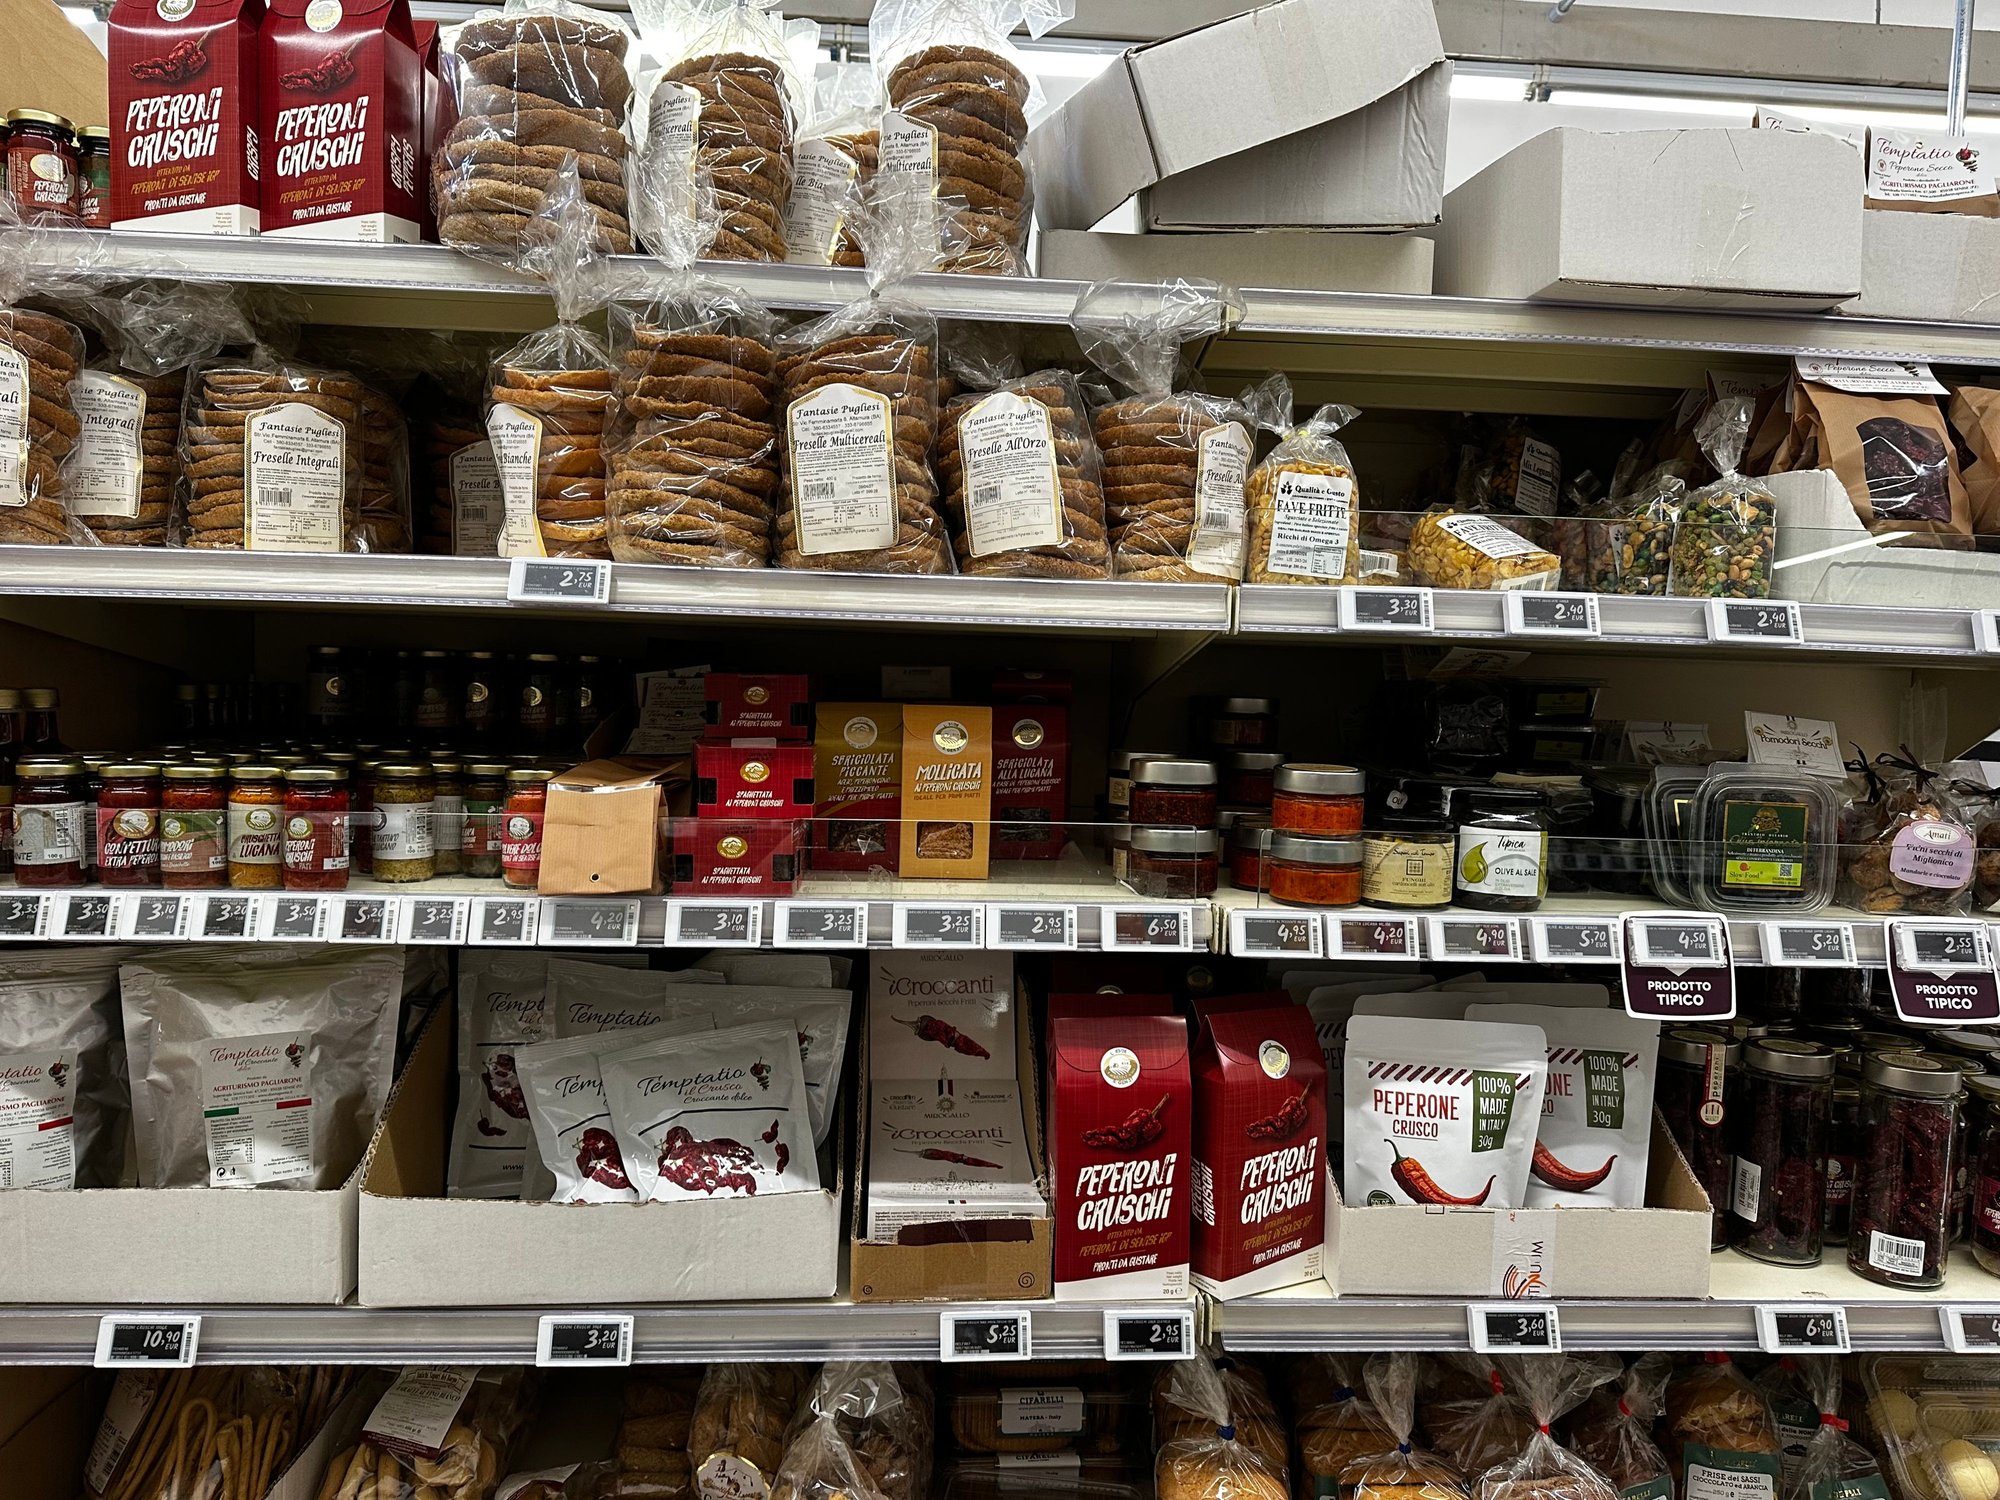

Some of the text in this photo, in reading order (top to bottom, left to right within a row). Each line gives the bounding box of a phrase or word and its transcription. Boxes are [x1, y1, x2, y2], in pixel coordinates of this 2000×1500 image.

[126, 87, 222, 132] PEPERONI
[275, 96, 369, 142] PEPERONI
[128, 123, 219, 168] CRUSCHI
[1877, 138, 1953, 164] Temptatio
[277, 132, 365, 178] CRUSCHI
[1889, 161, 1953, 173] Peperone Secco
[33, 181, 68, 194] PEPERONI
[1881, 179, 1974, 188] AGRITURISMO PAGLIARONE
[144, 192, 207, 211] PRONTI DA GUSTARE
[292, 201, 352, 220] PRONTI DA GUSTARE
[1868, 364, 1895, 373] Secco
[796, 402, 880, 419] Fantasie Pugliesi
[967, 409, 1043, 429] Fantasie Pugliesi
[85, 413, 135, 431] Integrali
[259, 422, 340, 438] Fantasie Pugliesi
[505, 422, 535, 432] Pugliesi
[794, 430, 886, 450] Freselle Multicereali
[967, 436, 1047, 463] Freselle All'Orzo
[252, 451, 339, 471] Freselle Integrali
[1205, 469, 1233, 482] Freselle
[1277, 500, 1347, 519] FAVE FRITTE
[1277, 533, 1299, 541] Ricchi
[1300, 534, 1308, 542] di
[1309, 537, 1334, 546] Omega
[559, 570, 593, 587] 2,75
[1387, 598, 1418, 615] 3,30
[1554, 603, 1583, 620] 2,40
[1757, 610, 1786, 627] 2,40
[1761, 735, 1828, 749] Pomodori Secchi
[831, 753, 895, 766] SBRICIOLATA
[839, 764, 889, 778] PICCANTE
[915, 762, 983, 781] MOLLICATA
[998, 767, 1054, 780] ALLA LUCANA
[921, 781, 953, 793] PEPERONI
[953, 781, 981, 791] CRUSCHI
[733, 799, 759, 807] PEPERONI
[759, 799, 784, 808] CRUSCHI
[1497, 835, 1527, 849] Tipica
[1924, 830, 1951, 840] Amati
[240, 844, 280, 857] LUCANA
[1912, 854, 1954, 866] Miglionico
[701, 875, 763, 884] AI PEPERONI CRUSCHI
[712, 866, 751, 876] SPAGHETTATA
[1495, 867, 1537, 877] OLIVE AL SALE
[7, 902, 38, 920] 3,35
[77, 902, 109, 920] 3,50
[147, 903, 176, 920] 3,10
[216, 904, 247, 922] 3,20
[285, 905, 316, 922] 3,50
[354, 906, 384, 923] 5,20
[422, 907, 453, 925] 3,25
[493, 908, 524, 926] 2,95
[591, 911, 623, 930] 4,20
[713, 913, 743, 931] 3,10
[820, 914, 853, 932] 3,25
[938, 915, 970, 933] 3,25
[1031, 916, 1062, 934] 2,95
[1147, 918, 1177, 937] 6,50
[1277, 924, 1306, 942] 4,95
[1373, 926, 1403, 945] 4,20
[1476, 928, 1504, 947] 4,90
[1579, 930, 1606, 947] 5,70
[1678, 931, 1706, 950] 4,50
[1812, 933, 1840, 951] 5,20
[1944, 936, 1972, 953] 2,55
[889, 975, 993, 996] iCroccanti
[1647, 980, 1712, 992] PRODOTTO
[1915, 984, 1978, 996] PRODOTTO
[1655, 993, 1704, 1006] TIPICO
[1925, 997, 1972, 1010] TIPICO
[209, 1045, 281, 1067] Temptatio
[1588, 1055, 1619, 1072] 100%
[213, 1077, 302, 1092] AGRITURISMO PAGLIARONE
[637, 1067, 746, 1096] Temptatio
[685, 1083, 742, 1095] il Crusco
[1477, 1076, 1511, 1095] 100%
[1591, 1074, 1619, 1092] MADE
[21, 1096, 65, 1108] PAGLIARONE
[683, 1093, 753, 1104] Croccante dolce
[1373, 1088, 1460, 1121] PEPERONE
[1479, 1097, 1509, 1115] MADE
[1592, 1094, 1620, 1108] IN ITALY
[1479, 1118, 1506, 1132] IN ITALY
[1592, 1110, 1611, 1127] 30g
[891, 1127, 1004, 1140] iCroccanti
[1392, 1119, 1439, 1138] CRUSCO
[1477, 1135, 1494, 1149] 30g
[1240, 1137, 1318, 1191] PEPERONI
[1076, 1153, 1177, 1197] PEPERONI
[1203, 1162, 1215, 1226] CRUSCHI
[1241, 1171, 1315, 1225] CRUSCHI
[1077, 1187, 1173, 1232] CRUSCHI
[1093, 1254, 1158, 1272] PRONTI DA GUSTARE
[986, 1325, 1017, 1344] 5,25
[1149, 1324, 1179, 1343] 2,95
[1516, 1318, 1545, 1336] 3,60
[1806, 1318, 1832, 1337] 6,90
[143, 1330, 181, 1348] 10,90
[584, 1329, 618, 1348] 3,20
[1003, 1336, 1016, 1344] EUR
[1019, 1396, 1064, 1405] CIFARELLI
[1692, 1475, 1734, 1488] CIOCCOLATO
[1702, 1470, 1761, 1483] FRISE dei SASSI
